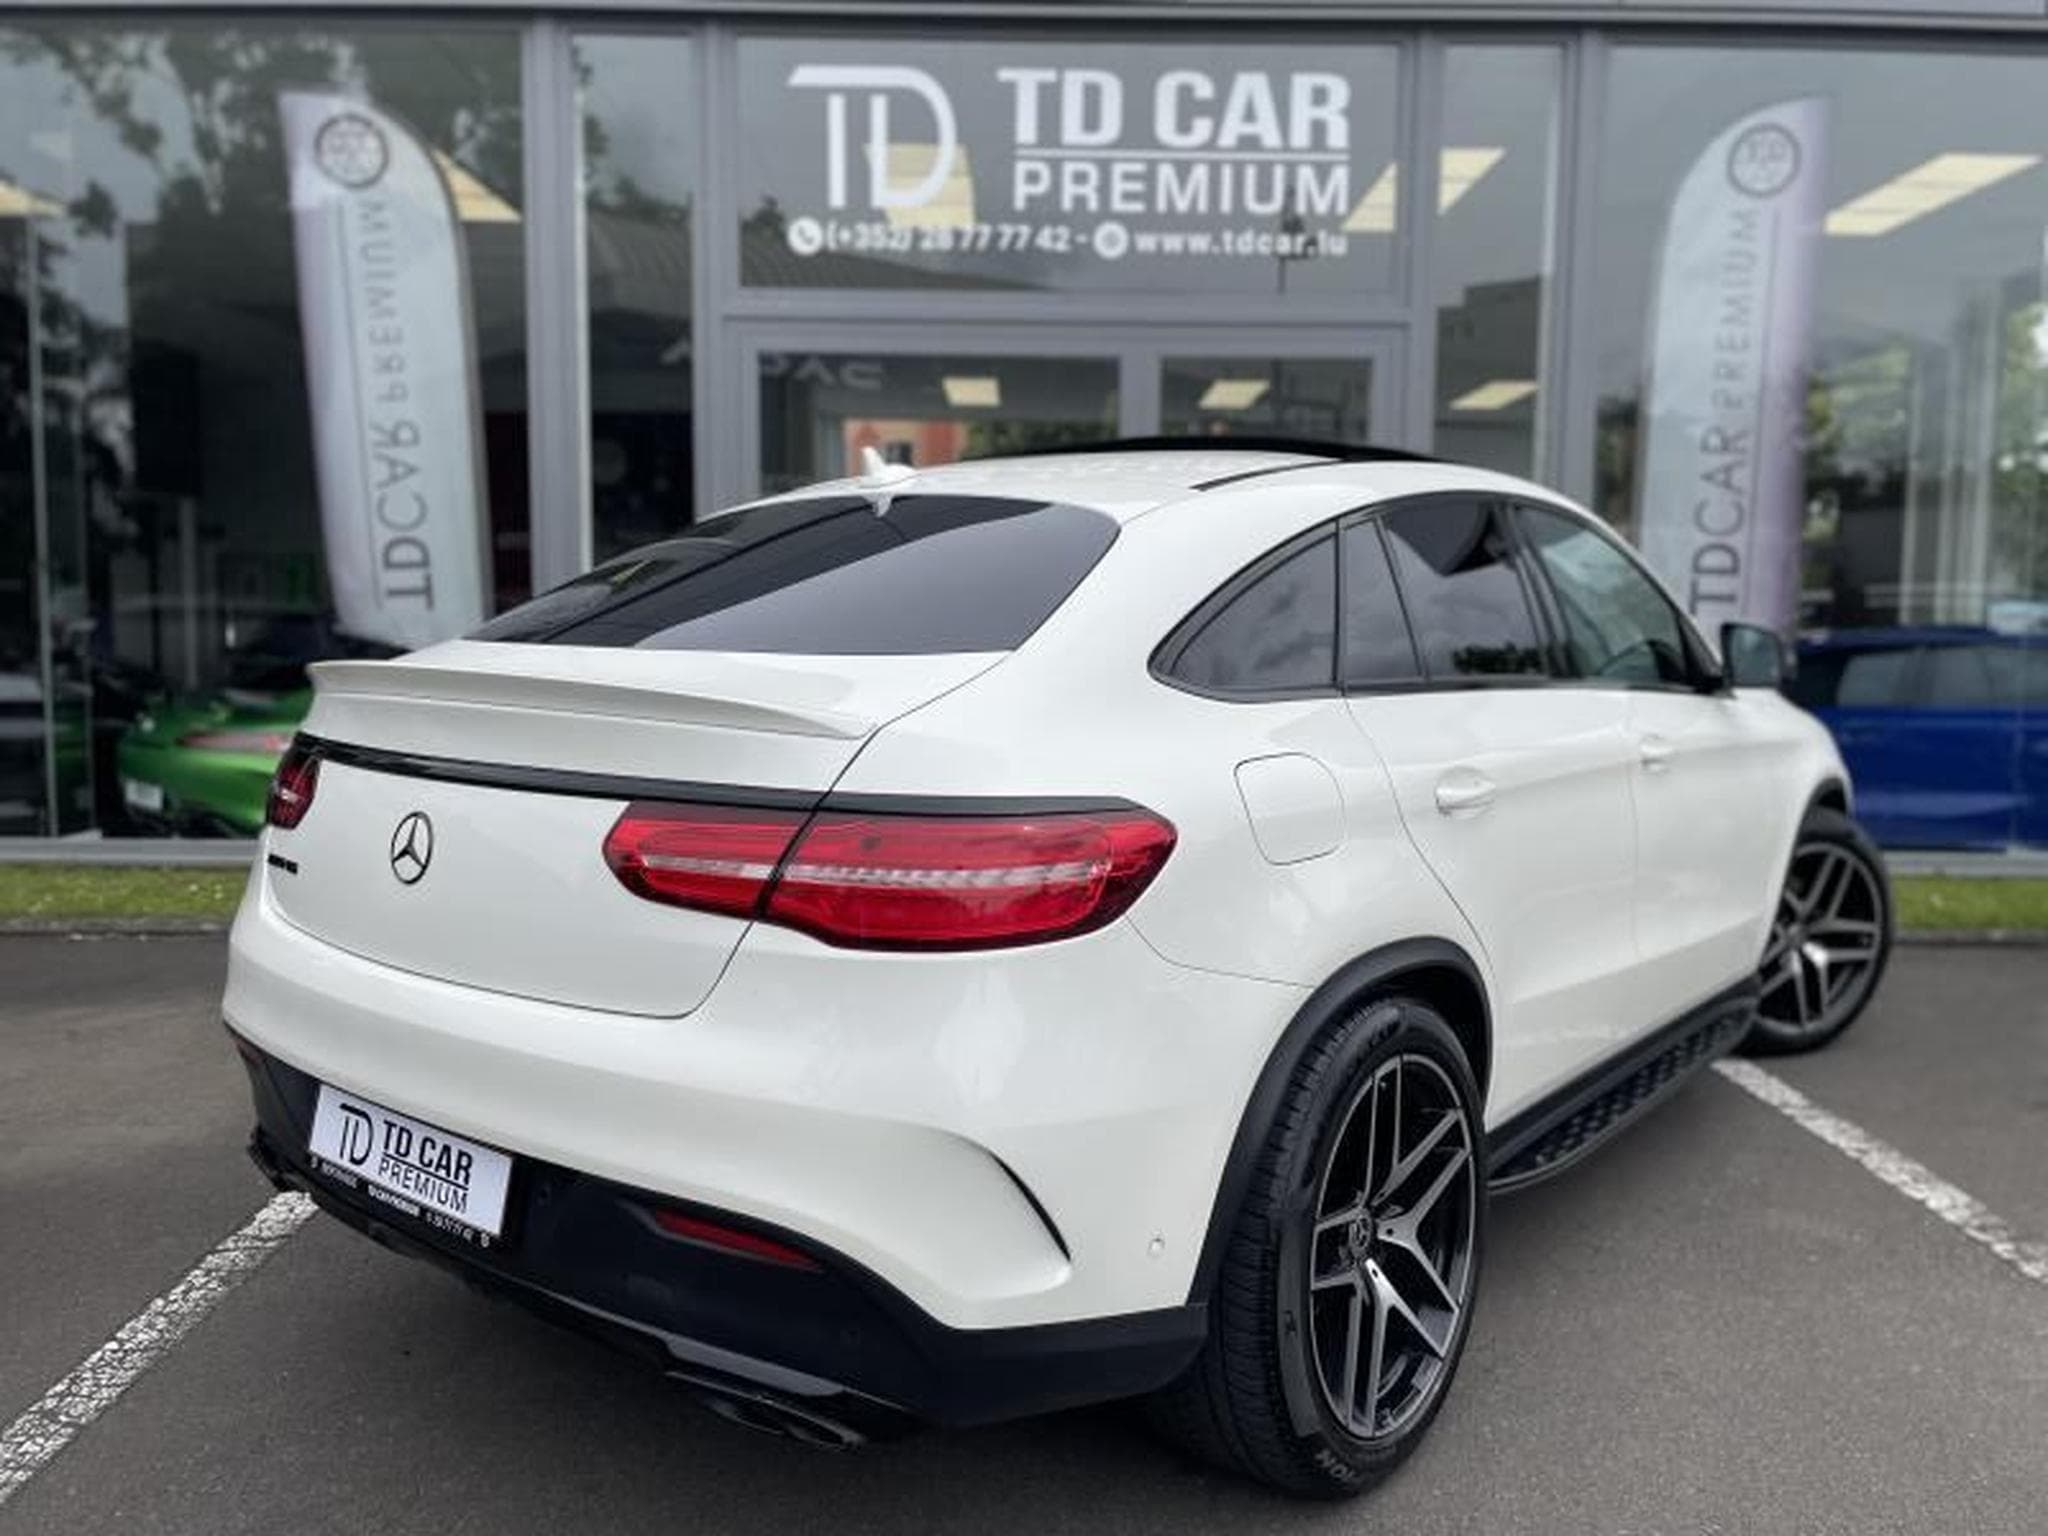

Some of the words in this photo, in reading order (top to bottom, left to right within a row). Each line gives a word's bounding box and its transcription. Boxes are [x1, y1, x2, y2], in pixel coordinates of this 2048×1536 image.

[996, 68, 1123, 146] TD
[1154, 71, 1351, 150] CAR
[1013, 161, 1350, 216] PREMIUM
[997, 223, 1032, 251] 77
[1034, 224, 1074, 253] 42
[1133, 228, 1349, 256] www.tdcar.lu
[1711, 207, 1760, 416] PREMIUM
[1689, 427, 1751, 615] TDCAR
[382, 1119, 413, 1159] TD
[419, 1136, 474, 1185] CAR
[377, 1158, 469, 1214] PREMIUM
